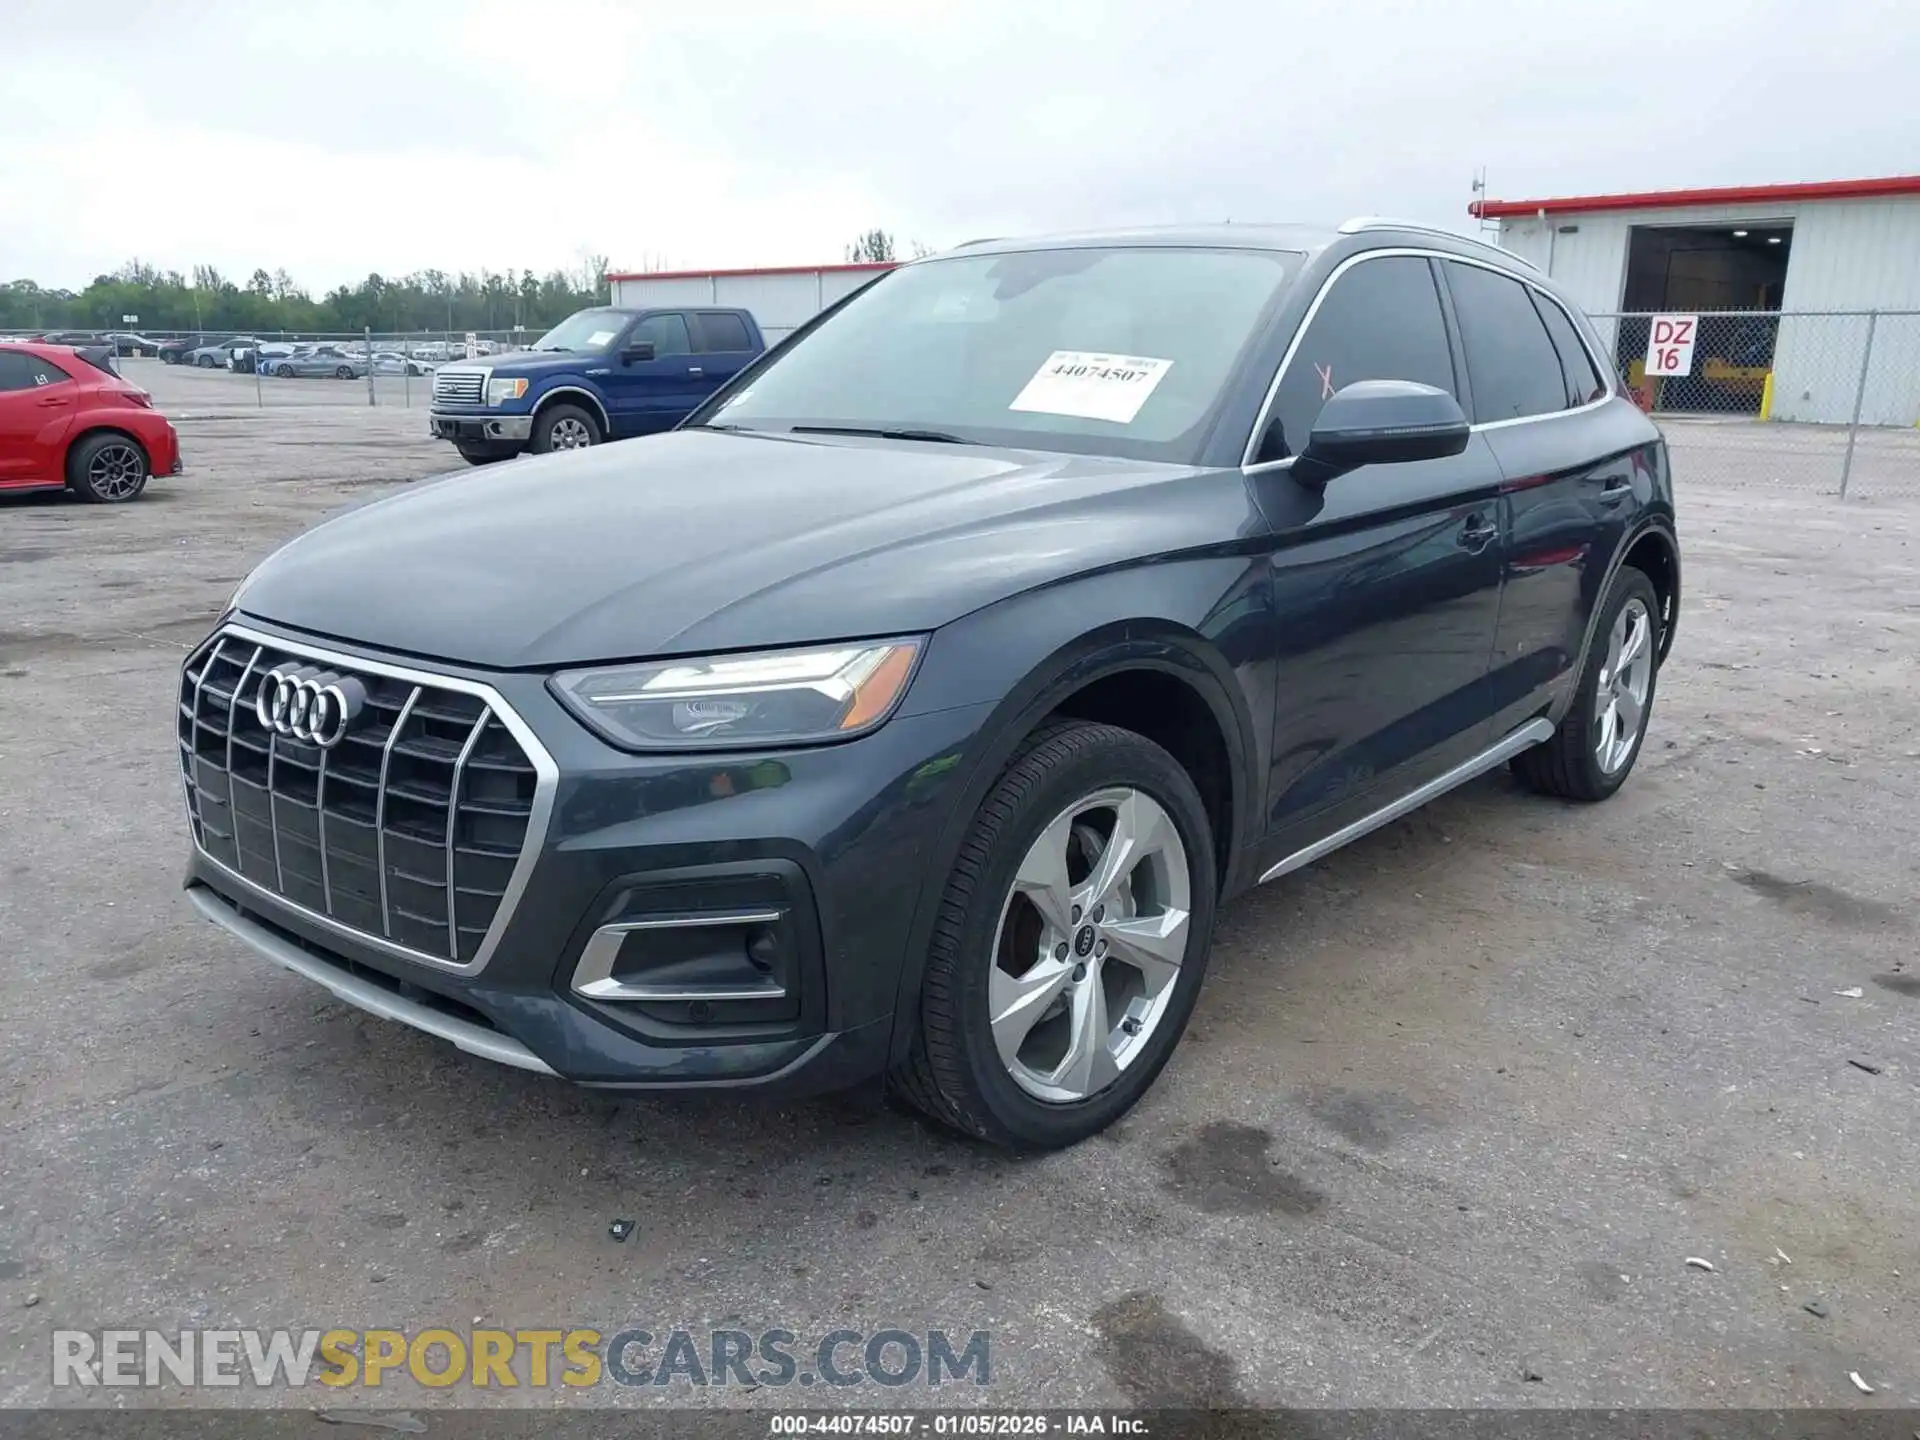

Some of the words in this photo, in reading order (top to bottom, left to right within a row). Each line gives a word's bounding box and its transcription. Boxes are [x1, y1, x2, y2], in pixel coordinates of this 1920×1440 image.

[1654, 321, 1692, 344] DZ
[1657, 348, 1680, 370] 16
[1051, 364, 1149, 382] 44074507
